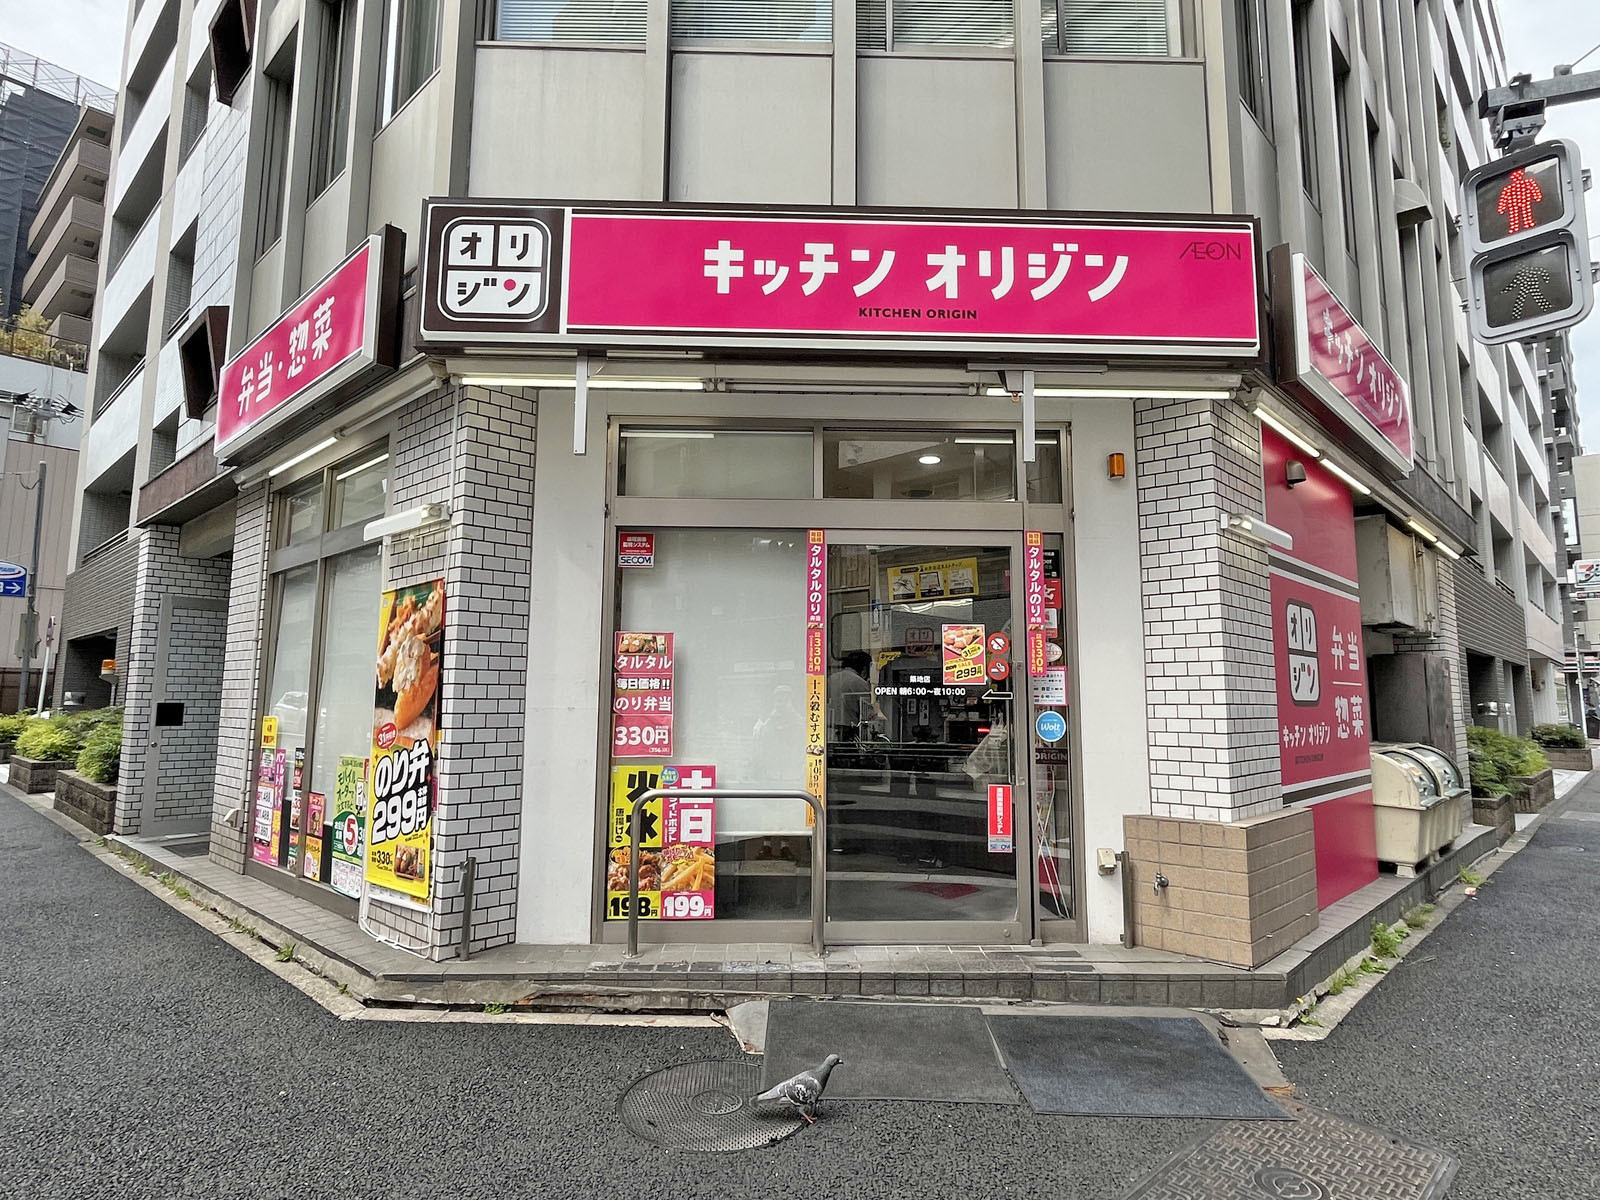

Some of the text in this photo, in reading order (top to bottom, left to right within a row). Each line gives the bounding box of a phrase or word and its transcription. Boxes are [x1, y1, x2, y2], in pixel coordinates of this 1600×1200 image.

[460, 232, 530, 260] オリ
[703, 240, 1129, 303] キッチン オリジン
[457, 277, 531, 308] ジン
[858, 307, 977, 320] KITCHEN ORIGIN
[620, 556, 652, 564] SECOM
[1289, 612, 1313, 644] オリ
[1331, 625, 1360, 671] 弁当
[616, 655, 672, 670] タルタル
[874, 687, 898, 696] OPEN
[1293, 664, 1316, 695] ジン
[615, 697, 672, 712] のり弁当
[1334, 695, 1364, 739] 惣菜
[615, 726, 669, 746] 330円
[1040, 723, 1061, 732] Wolt
[1282, 721, 1331, 748] キッチン オリジン
[374, 738, 429, 798] のり弁
